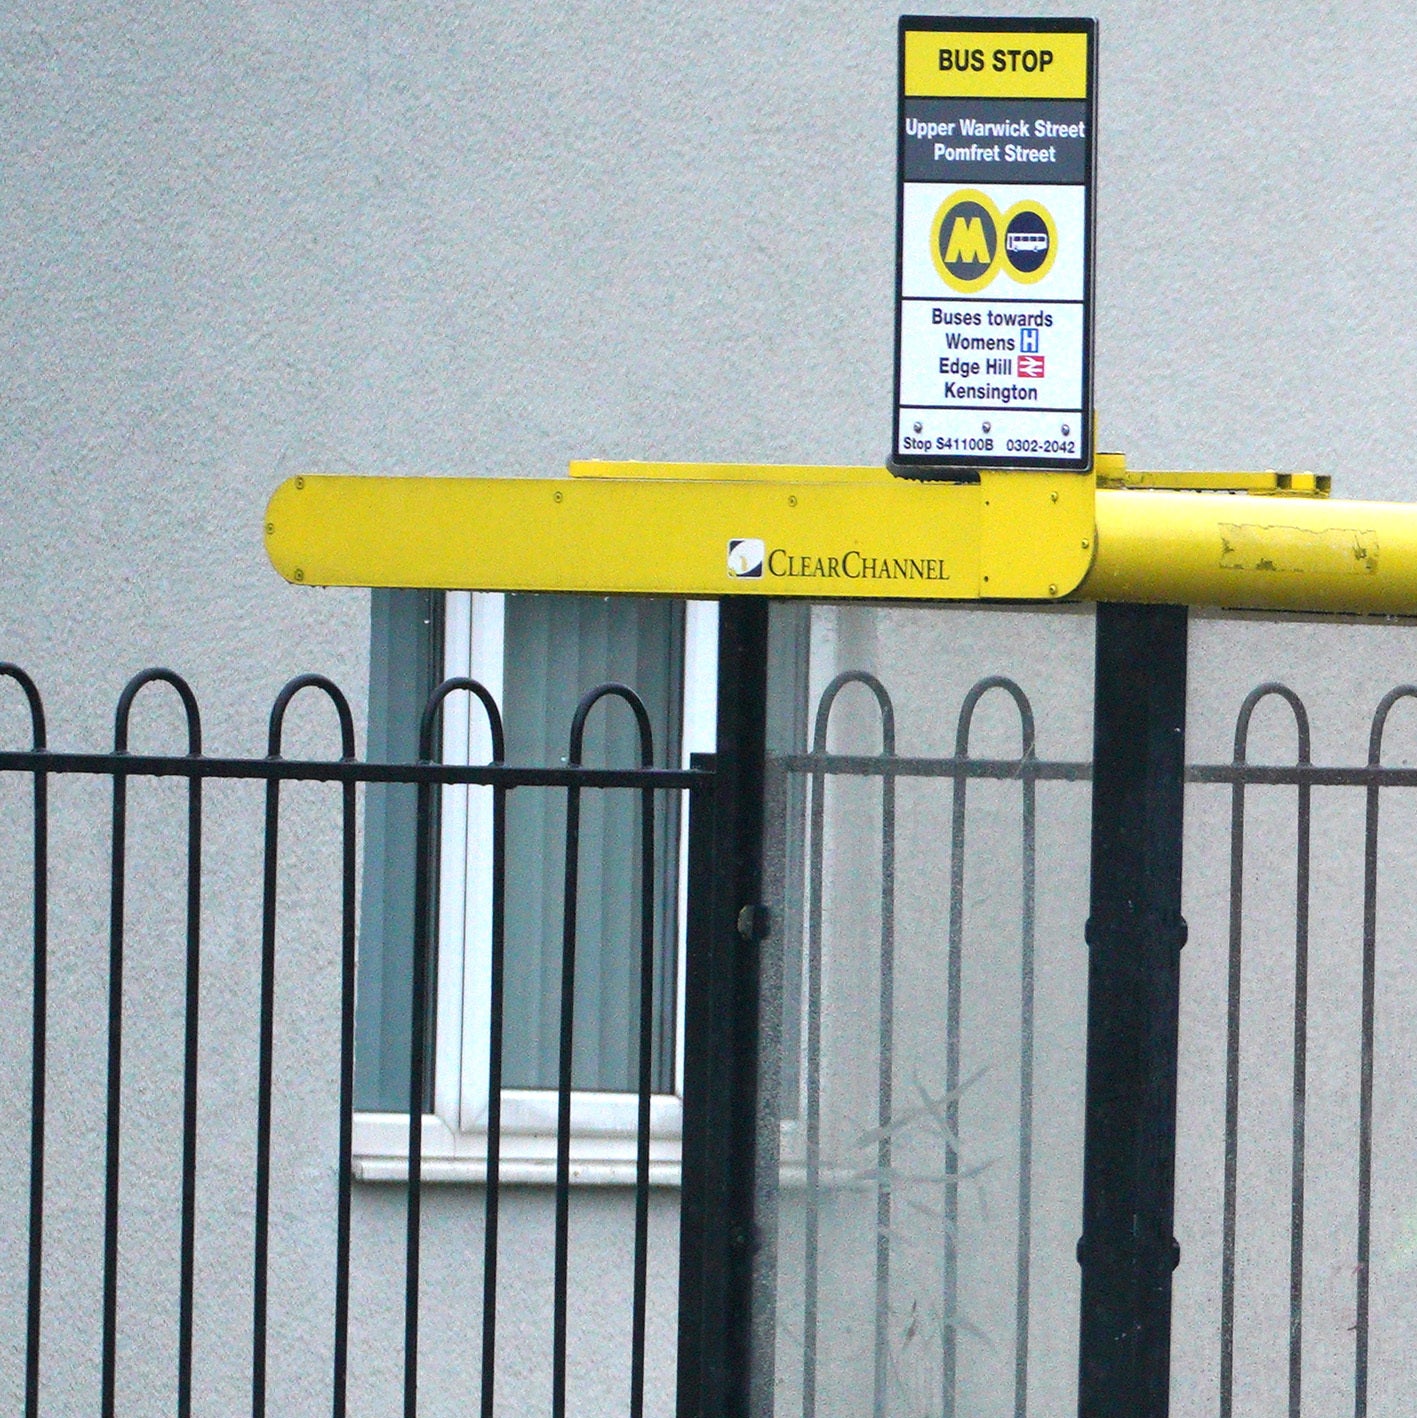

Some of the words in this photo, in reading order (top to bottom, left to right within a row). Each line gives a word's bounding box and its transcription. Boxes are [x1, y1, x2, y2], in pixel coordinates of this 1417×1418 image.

[939, 49, 985, 71] BUS
[992, 50, 1053, 72] STOP
[905, 118, 955, 139] Upper
[959, 118, 1030, 137] Warwick
[1034, 120, 1086, 138] Street
[934, 143, 1000, 161] Pomfret
[1004, 144, 1056, 162] Street
[931, 308, 982, 326] Buses
[987, 310, 1053, 327] towards
[945, 333, 1015, 351] Womens
[939, 357, 980, 377] Edge
[986, 358, 1012, 375] Hill
[944, 382, 1038, 403] Kensington
[903, 437, 932, 452] Stop
[936, 438, 994, 451] S41100B
[1006, 439, 1076, 453] 0302-2042
